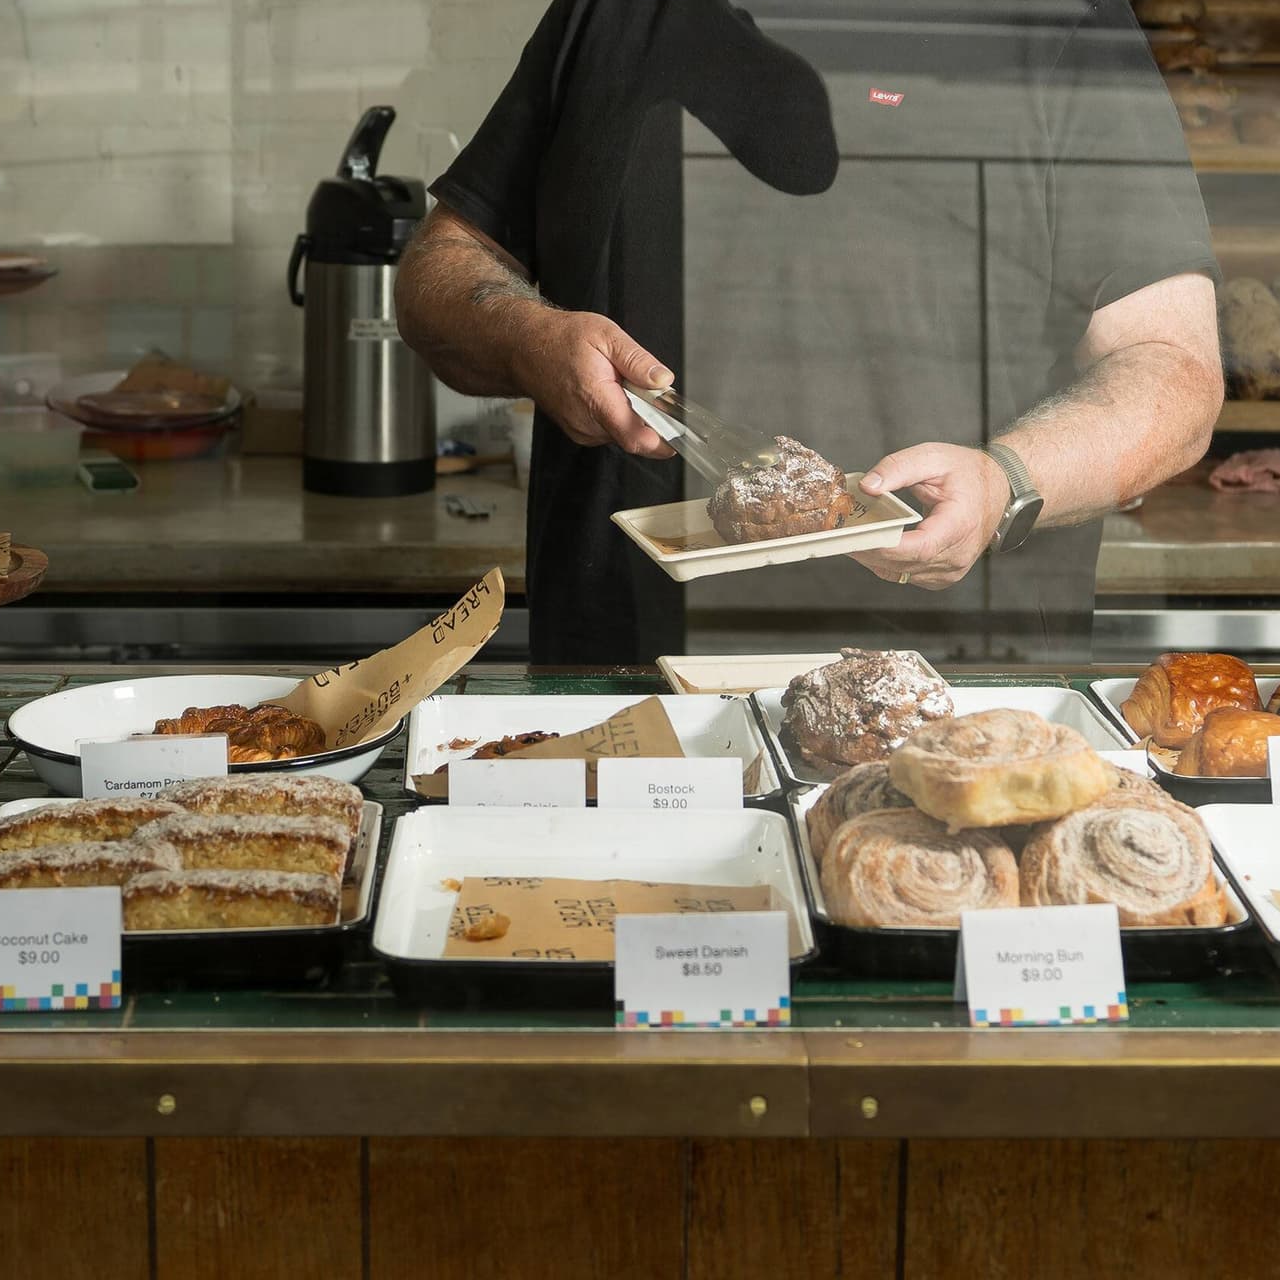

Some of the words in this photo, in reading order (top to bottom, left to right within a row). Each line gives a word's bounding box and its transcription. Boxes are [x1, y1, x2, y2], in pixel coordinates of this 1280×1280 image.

[105, 780, 162, 791] Cardamom
[647, 783, 696, 795] Bostock
[653, 797, 687, 808] $9.00
[52, 932, 89, 945] Cake
[18, 950, 60, 965] $9.00
[655, 946, 700, 960] Sweet
[702, 944, 748, 959] Danish
[996, 950, 1050, 967] Morning
[1054, 949, 1084, 964] Bun
[682, 962, 723, 977] $8.50
[1021, 967, 1063, 983] $9.00
